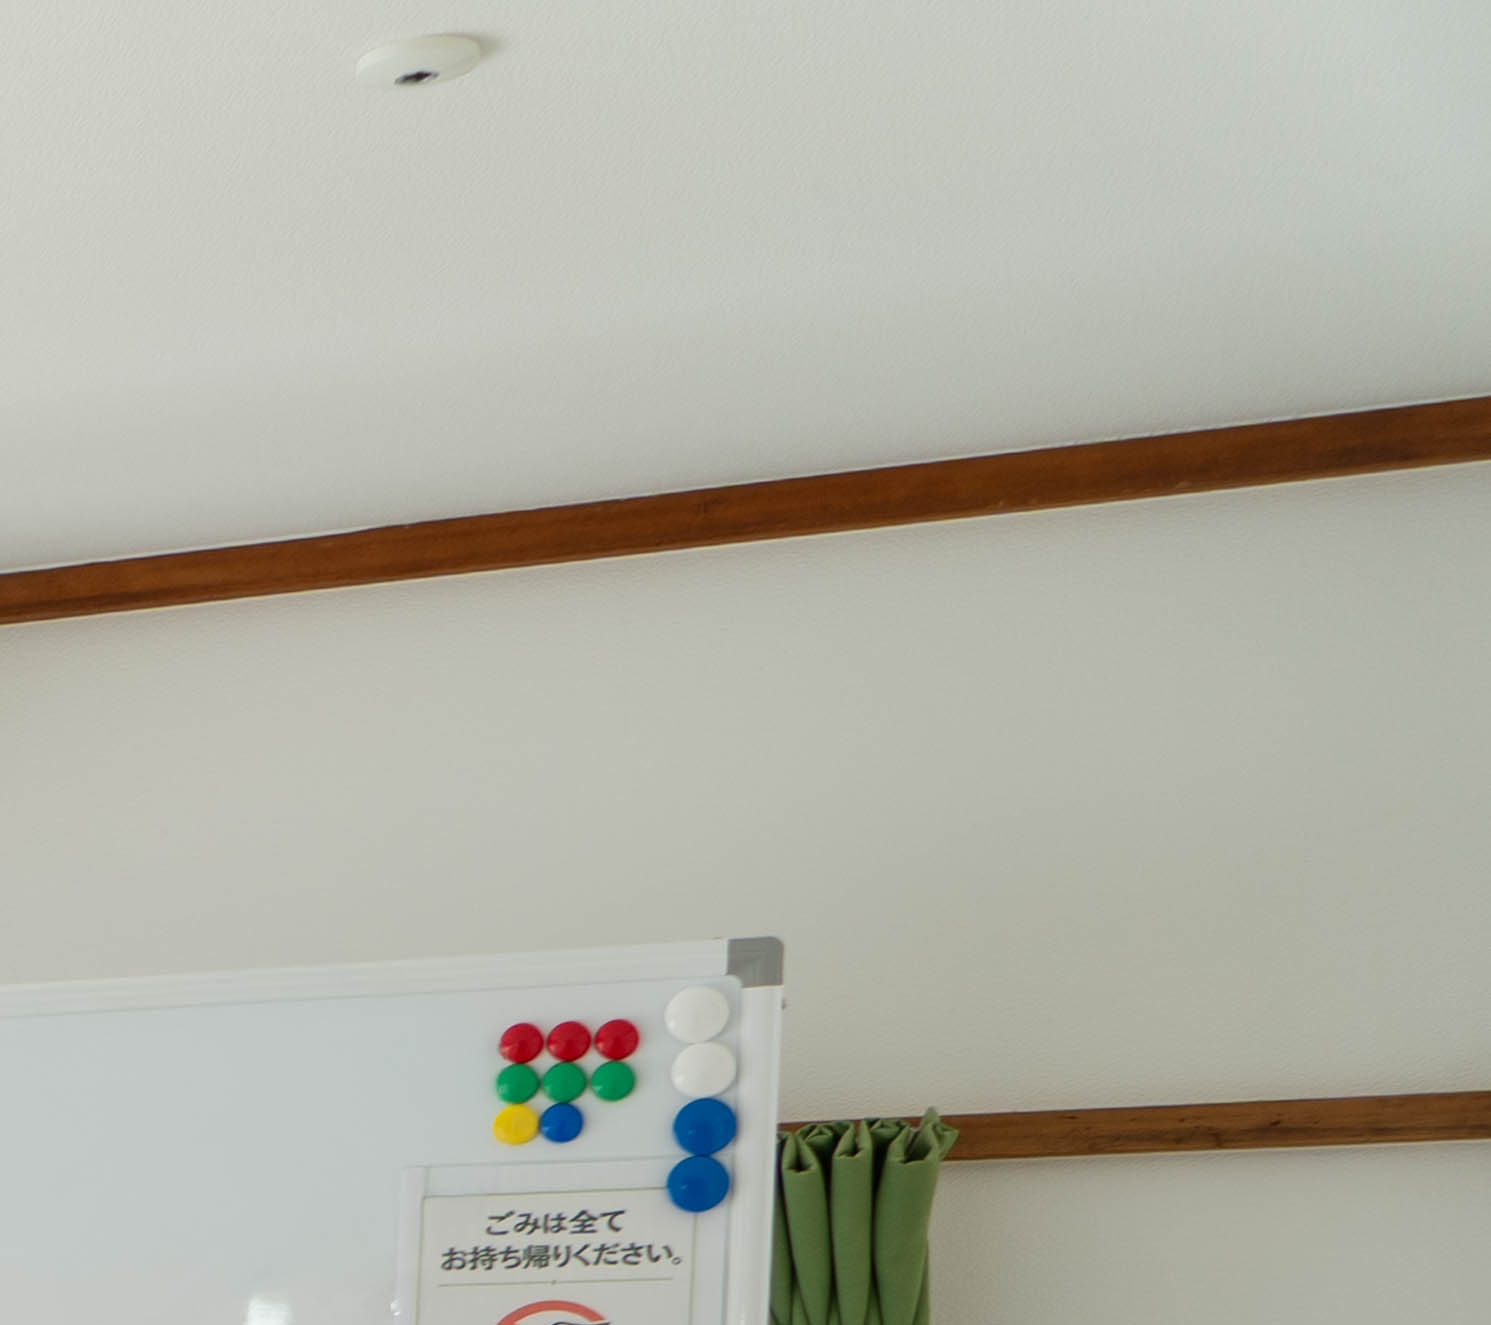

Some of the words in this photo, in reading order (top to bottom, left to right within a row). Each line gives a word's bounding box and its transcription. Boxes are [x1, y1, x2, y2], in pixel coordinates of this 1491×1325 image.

[484, 1208, 628, 1237] ごみは全て
[440, 1242, 685, 1273] お持ち帰りください。
